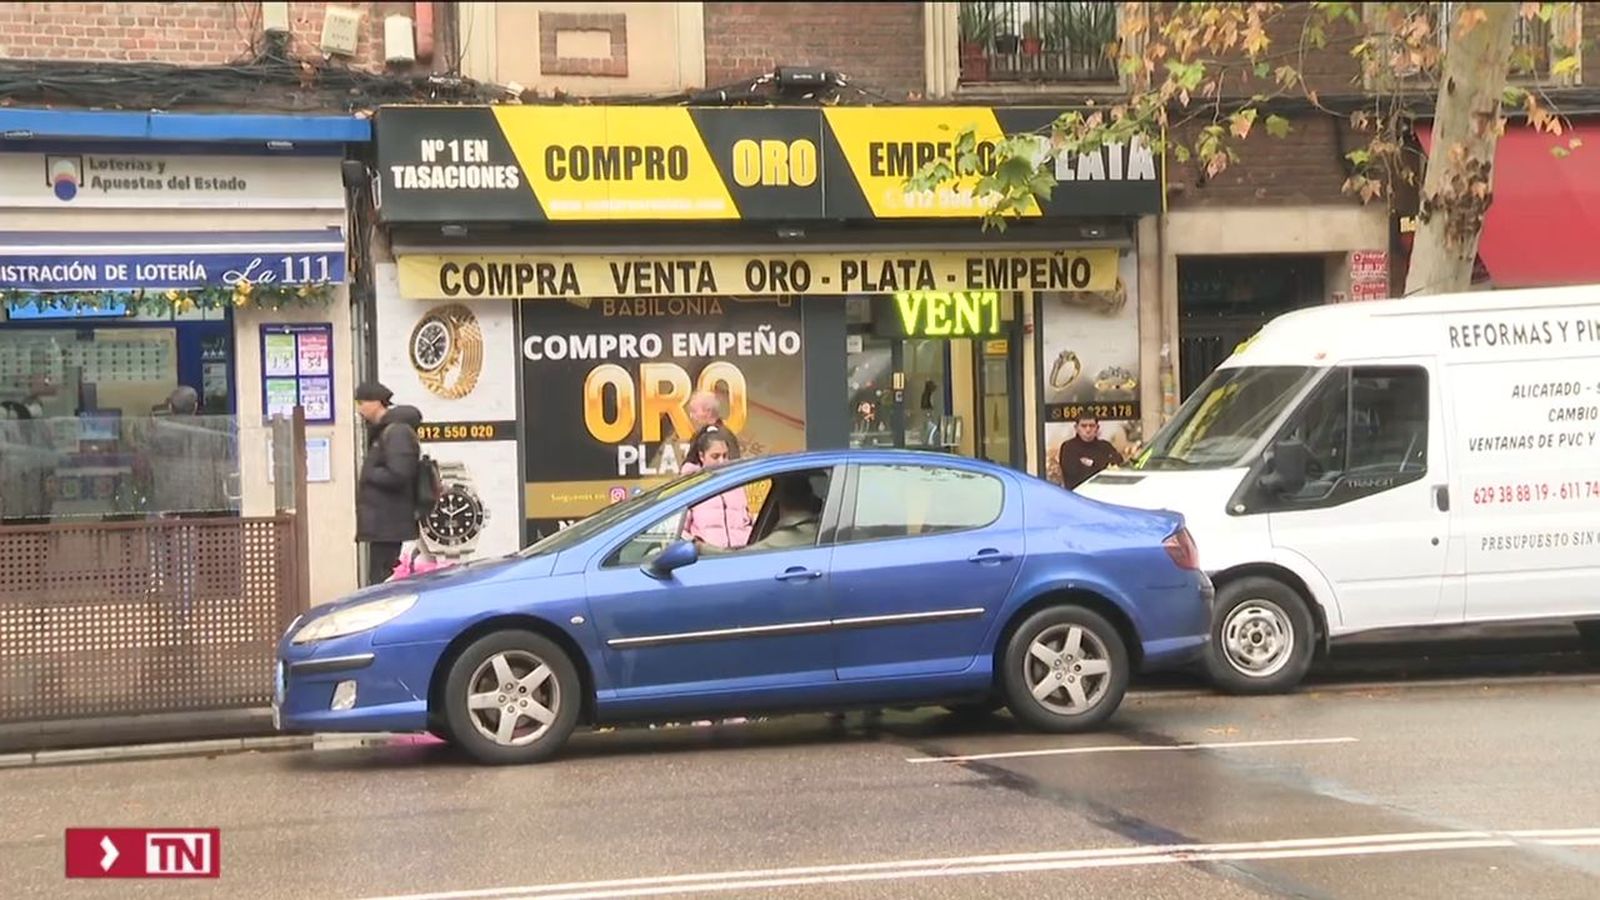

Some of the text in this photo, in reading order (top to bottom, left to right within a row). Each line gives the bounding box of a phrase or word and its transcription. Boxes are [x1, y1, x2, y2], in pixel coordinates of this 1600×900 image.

[421, 139, 488, 161] Nº 1 EN
[157, 161, 166, 174] y
[544, 144, 689, 182] COMPRO
[732, 139, 818, 188] ORO
[91, 175, 247, 193] Apuestas del Estado
[391, 165, 520, 190] TASACIONES
[1, 256, 331, 284] ISTRACIÓN DE LOTERÍA La 111
[439, 262, 581, 297] COMPRA
[609, 260, 718, 294] VENTA
[745, 259, 811, 292] ORO
[841, 259, 937, 291] PLATA
[966, 250, 1091, 290] EMPEÑO
[603, 299, 723, 316] BABILONIA
[897, 290, 998, 336] VENT
[524, 325, 801, 360] COMPRO EMPEÑO
[1449, 321, 1552, 348] REFORMAS
[1557, 321, 1568, 342] Y
[1511, 381, 1581, 398] ALICATADO
[583, 361, 748, 443] ORO
[1548, 406, 1598, 422] CAMBIO
[417, 425, 493, 438] 912 550 020
[1469, 432, 1595, 451] VENTANAS DE PVC Y
[617, 443, 691, 476] PLA
[1473, 487, 1494, 504] 629
[1499, 485, 1513, 502] 38
[1516, 484, 1531, 501] 88
[1535, 483, 1548, 500] 19
[1560, 482, 1580, 499] 611
[1481, 532, 1569, 551] PRESUPUESTO
[1572, 531, 1593, 546] SIN
